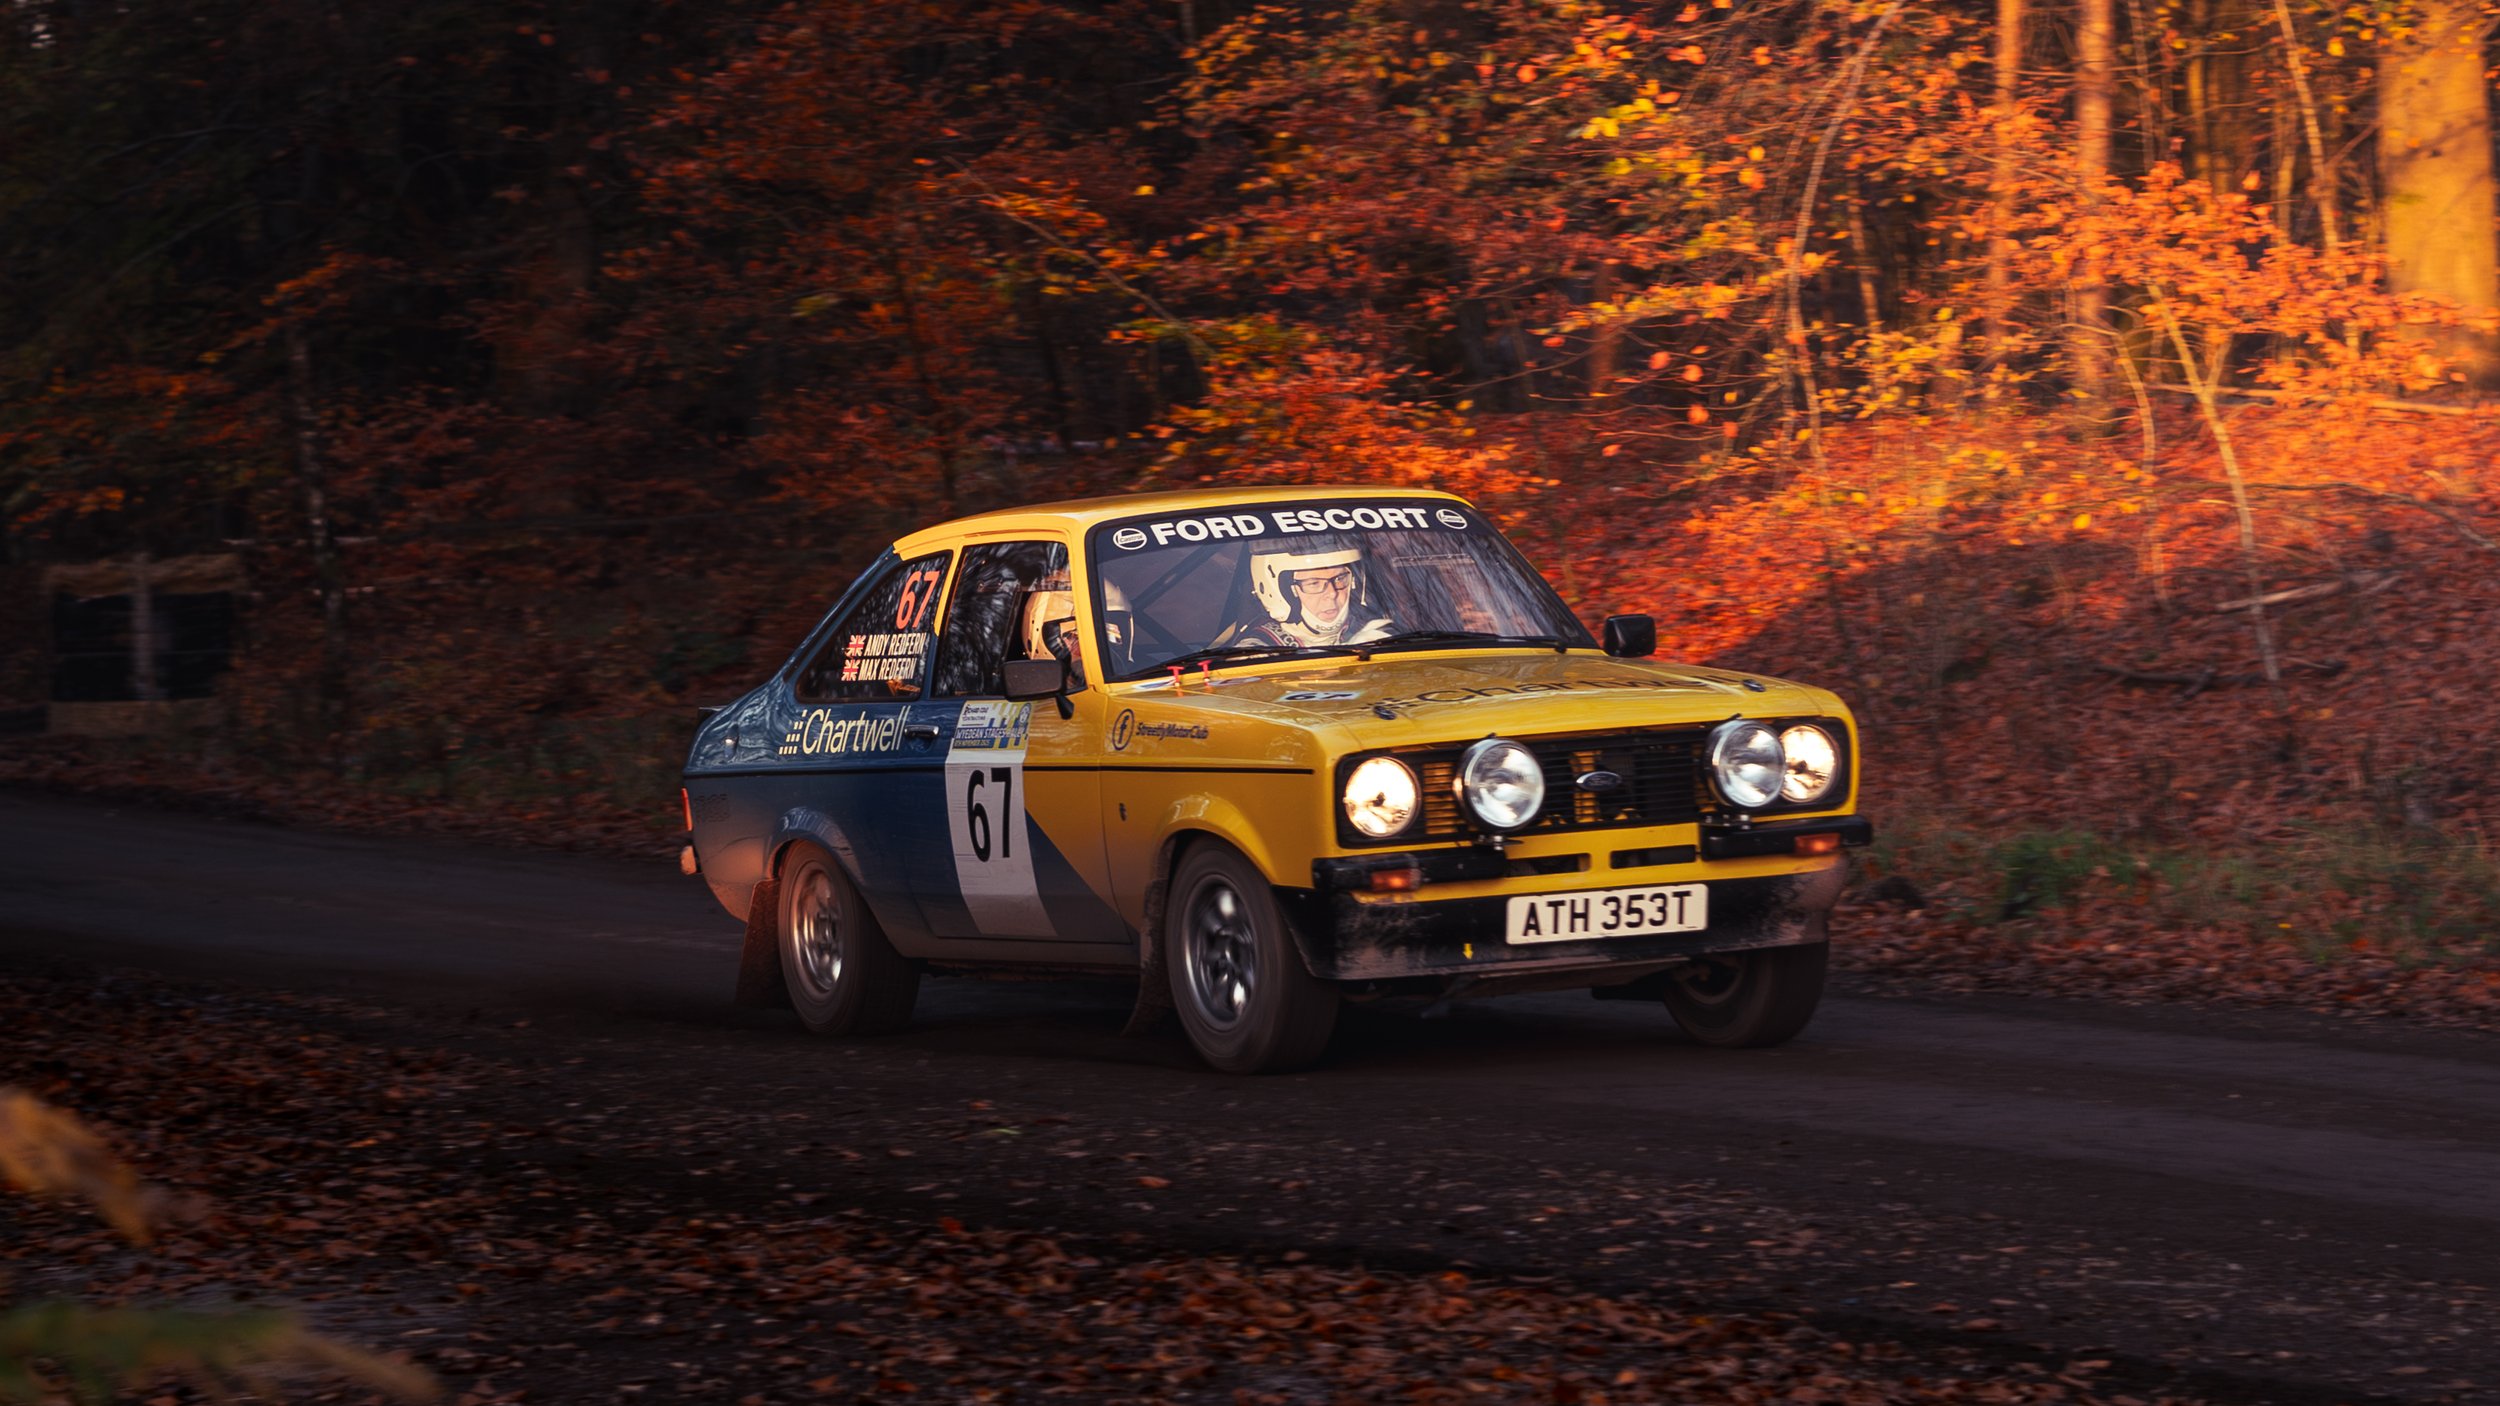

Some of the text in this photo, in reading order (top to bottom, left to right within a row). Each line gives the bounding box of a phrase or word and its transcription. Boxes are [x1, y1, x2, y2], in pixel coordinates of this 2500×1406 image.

[1150, 508, 1429, 545] FORD ESCORT
[896, 571, 939, 630] 67
[864, 633, 926, 656] ANDY REDFERN
[858, 658, 917, 681] MAX REDFERN
[1416, 674, 1741, 702] Chartwell
[802, 705, 911, 754] Chartwell
[967, 767, 1012, 862] 67
[1522, 890, 1692, 937] ATH 353T
